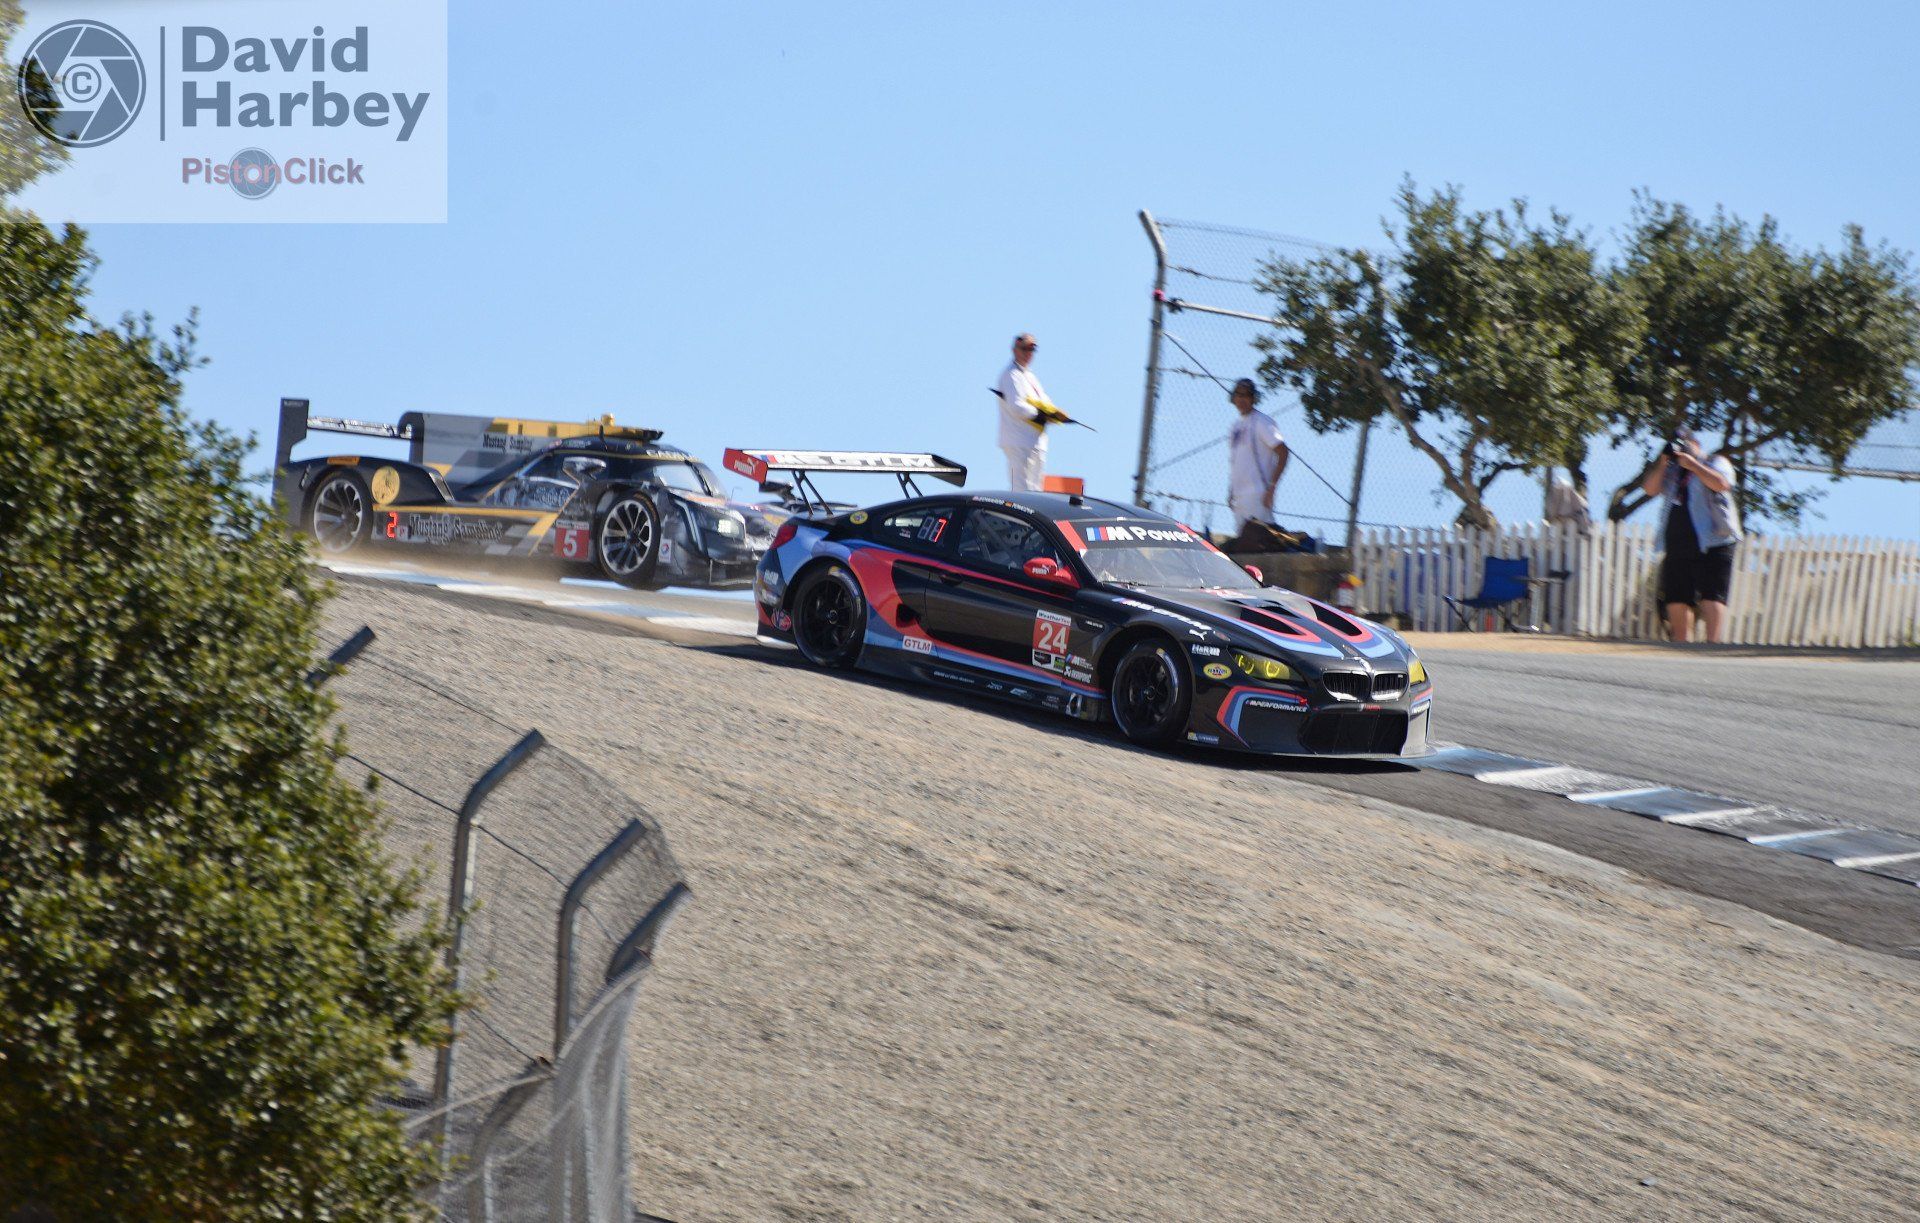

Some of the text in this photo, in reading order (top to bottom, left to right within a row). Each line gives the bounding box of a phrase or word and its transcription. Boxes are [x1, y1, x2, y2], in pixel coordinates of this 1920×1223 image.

[387, 511, 398, 538] 2
[1129, 526, 1194, 543] Power
[562, 530, 578, 558] 5
[904, 638, 932, 653] GTLM
[1038, 622, 1067, 654] 24
